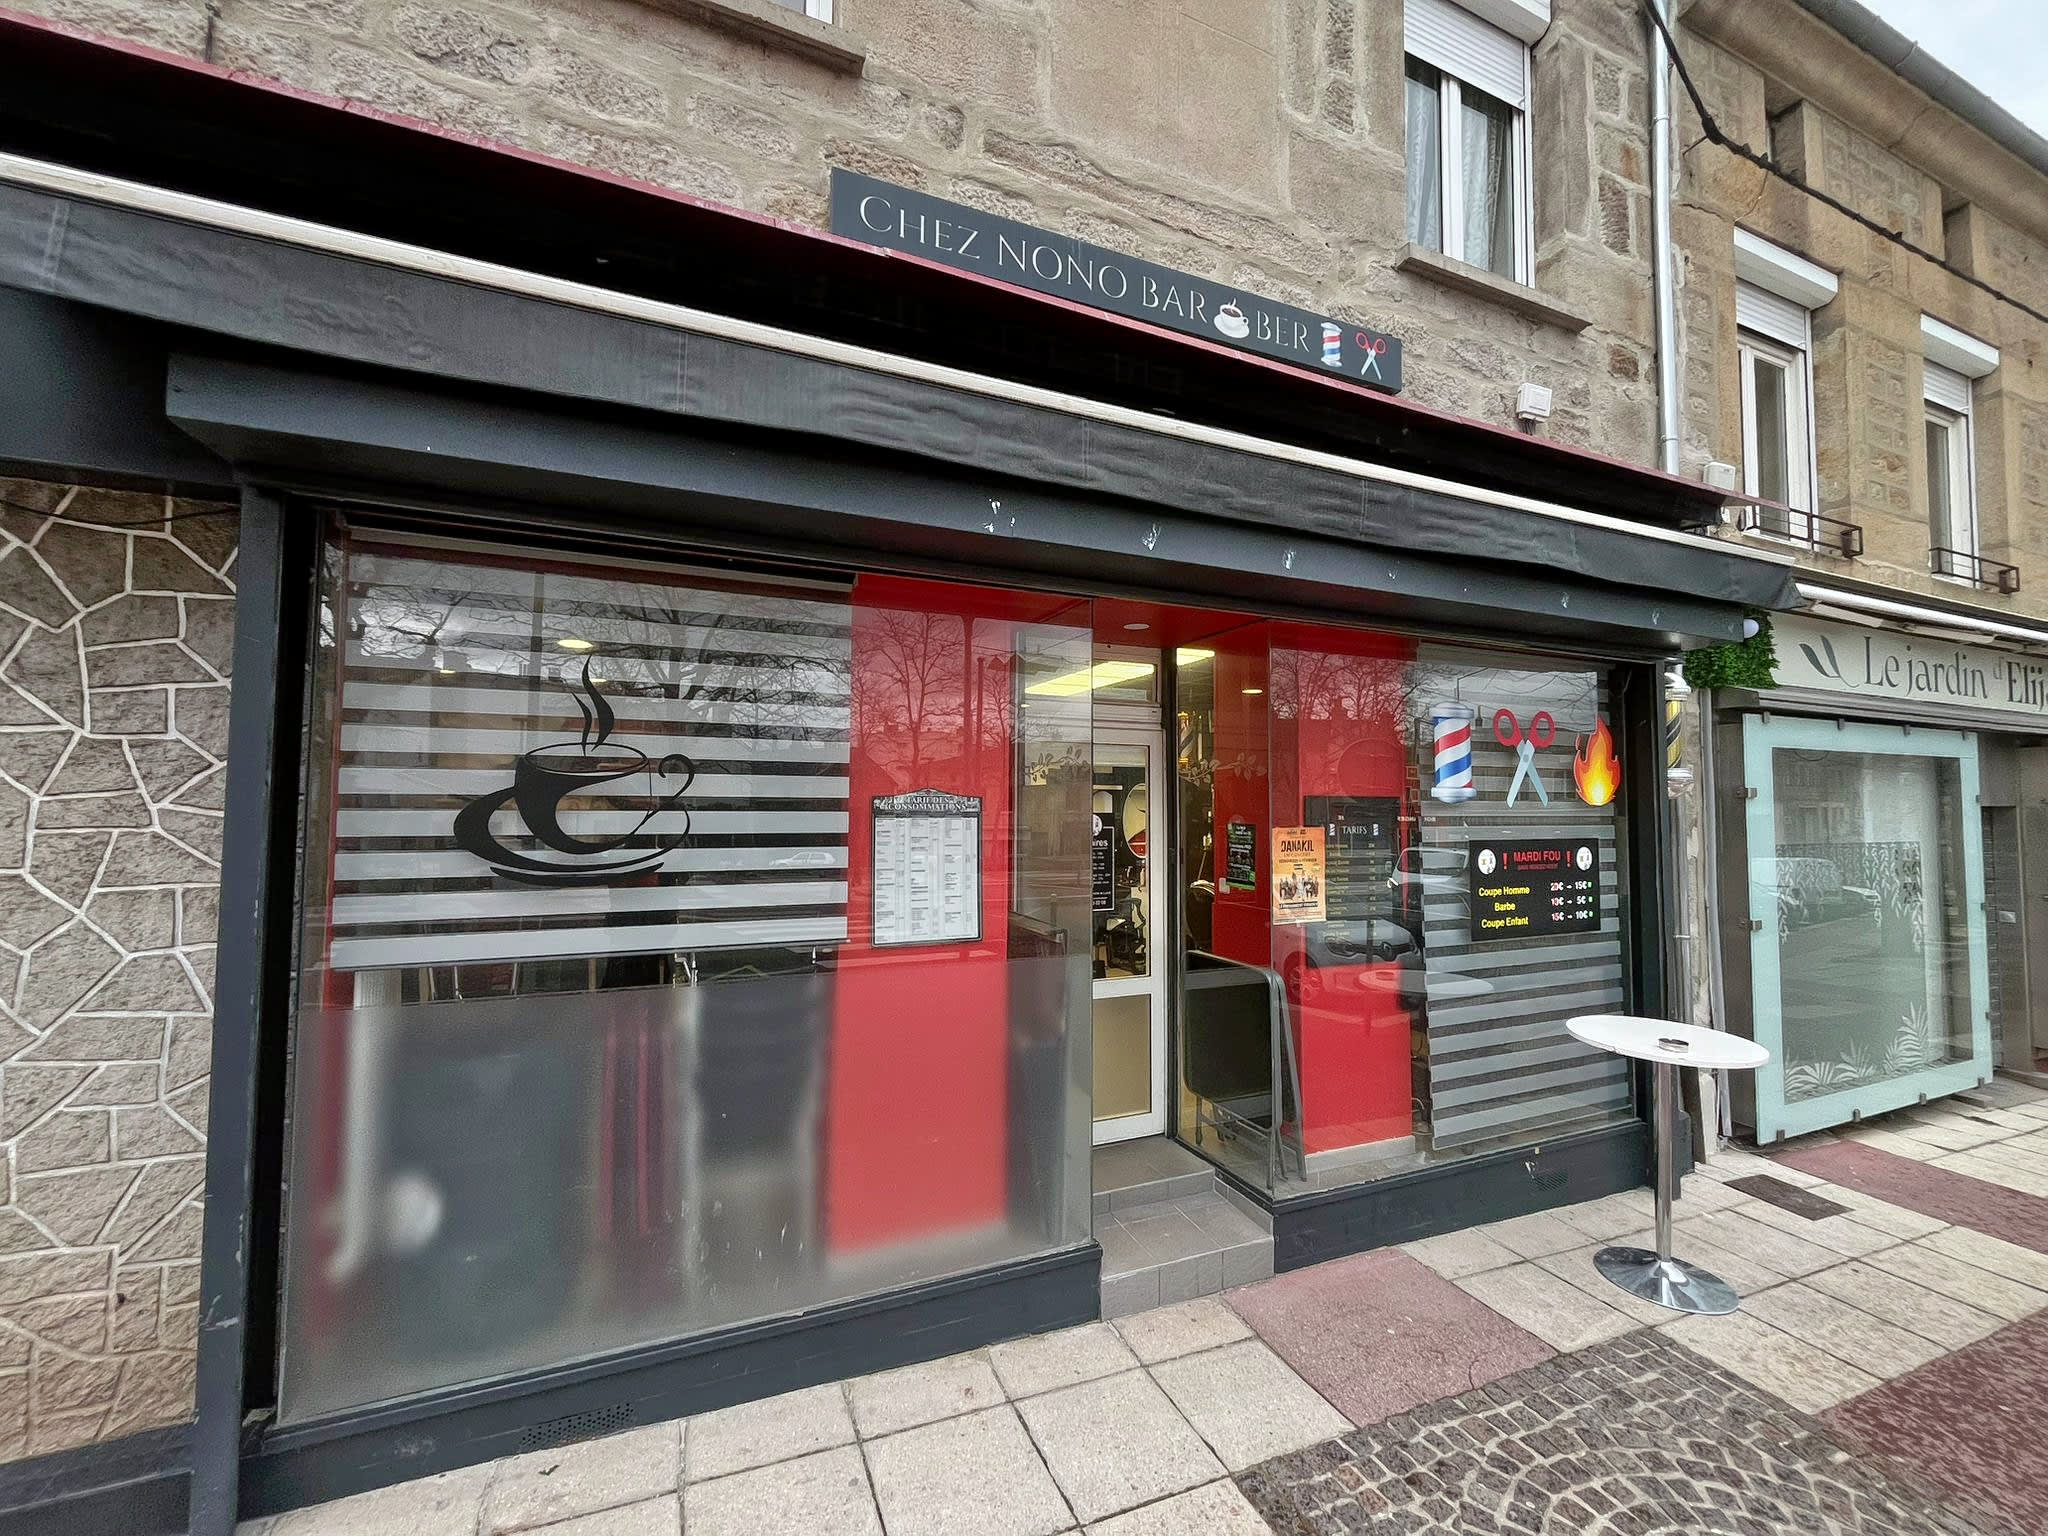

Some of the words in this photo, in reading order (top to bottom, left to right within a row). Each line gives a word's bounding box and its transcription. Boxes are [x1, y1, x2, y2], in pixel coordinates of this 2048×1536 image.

[858, 195, 981, 260] CHEZ
[996, 233, 1129, 301] NONO
[1141, 275, 1208, 325] BAR
[1256, 310, 1310, 353] BER
[1864, 636, 1900, 688] Le
[1905, 645, 1988, 700] jardin
[888, 803, 966, 811] CONSOMMATIONS
[1342, 825, 1368, 835] TARIFS
[1281, 839, 1315, 853] DANAKIL
[1513, 851, 1542, 862] MARDI
[1543, 850, 1561, 861] FOU
[1478, 887, 1502, 898] Coupe
[1503, 885, 1531, 896] Homme
[1494, 902, 1516, 912] Barbe
[1481, 918, 1505, 929] Coupe
[1505, 916, 1529, 926] Enfant
